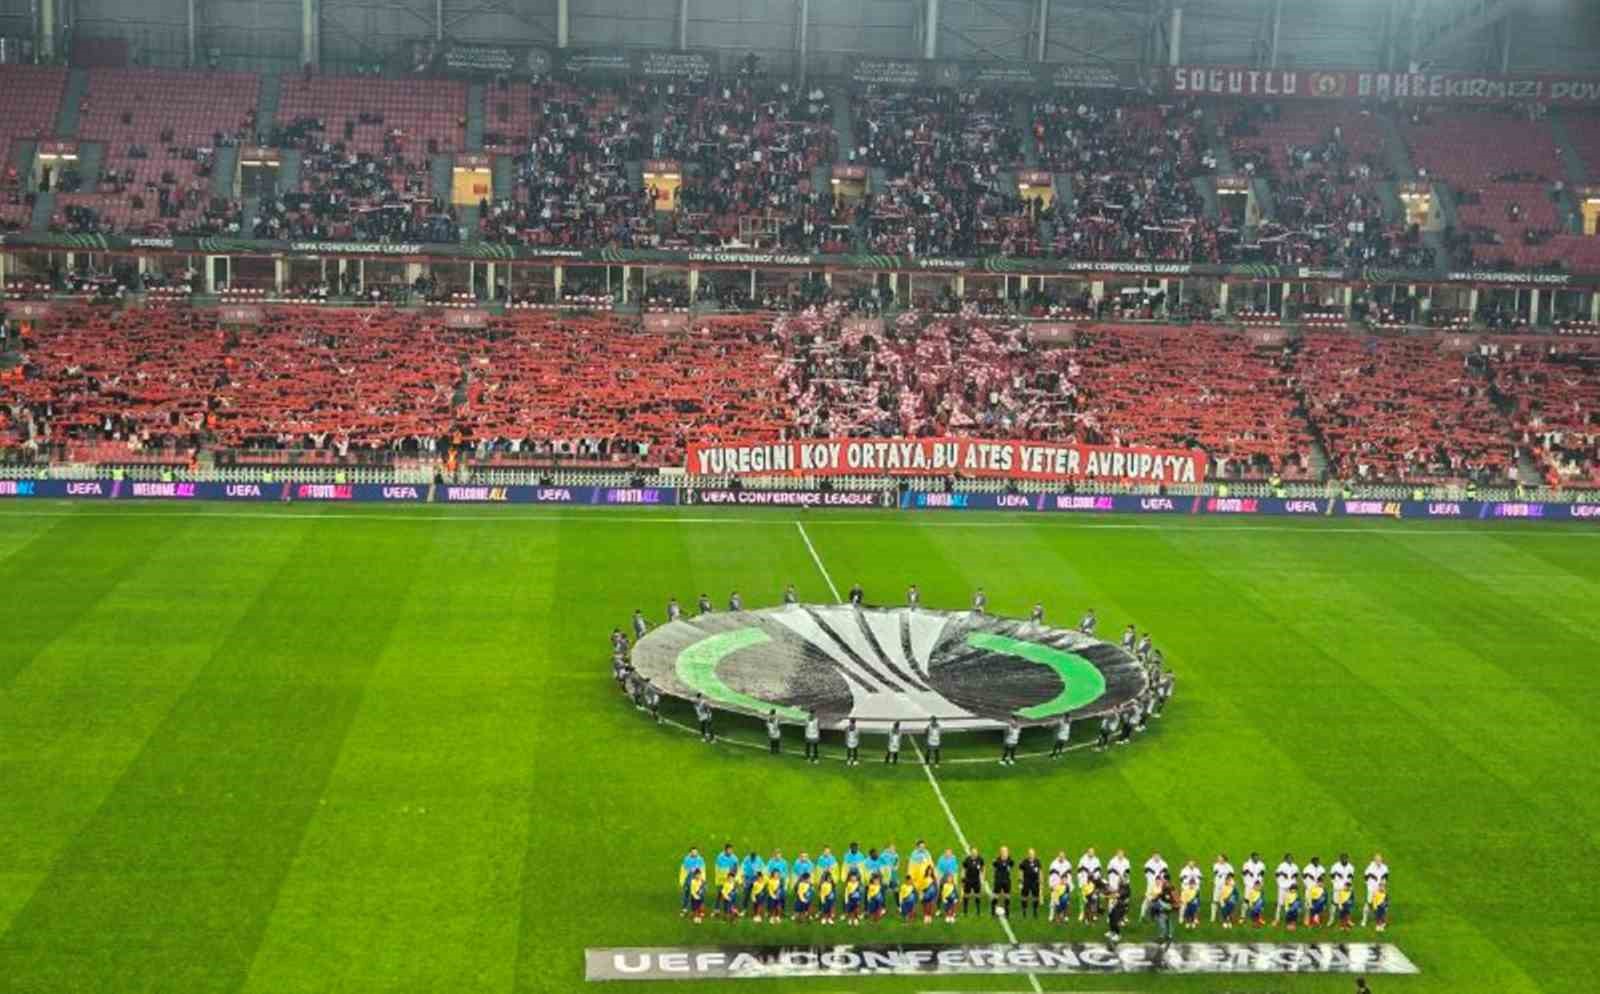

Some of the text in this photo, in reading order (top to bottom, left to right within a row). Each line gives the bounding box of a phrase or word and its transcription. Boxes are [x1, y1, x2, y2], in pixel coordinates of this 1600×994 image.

[801, 443, 841, 469] KOY
[1019, 446, 1082, 475] YETER
[66, 482, 102, 495] UEFA
[226, 484, 261, 496] UEFA
[382, 487, 418, 498] UEFA
[537, 488, 571, 501] UEFA
[702, 491, 873, 504] UEFA CONFERENCE LEAGUE
[997, 495, 1029, 507] UEFA
[1141, 497, 1173, 510] UEFA
[1285, 500, 1318, 513] UEFA
[1428, 503, 1460, 515] UEFA
[613, 951, 757, 972] UEFA
[781, 948, 1151, 970] CONFERENCE
